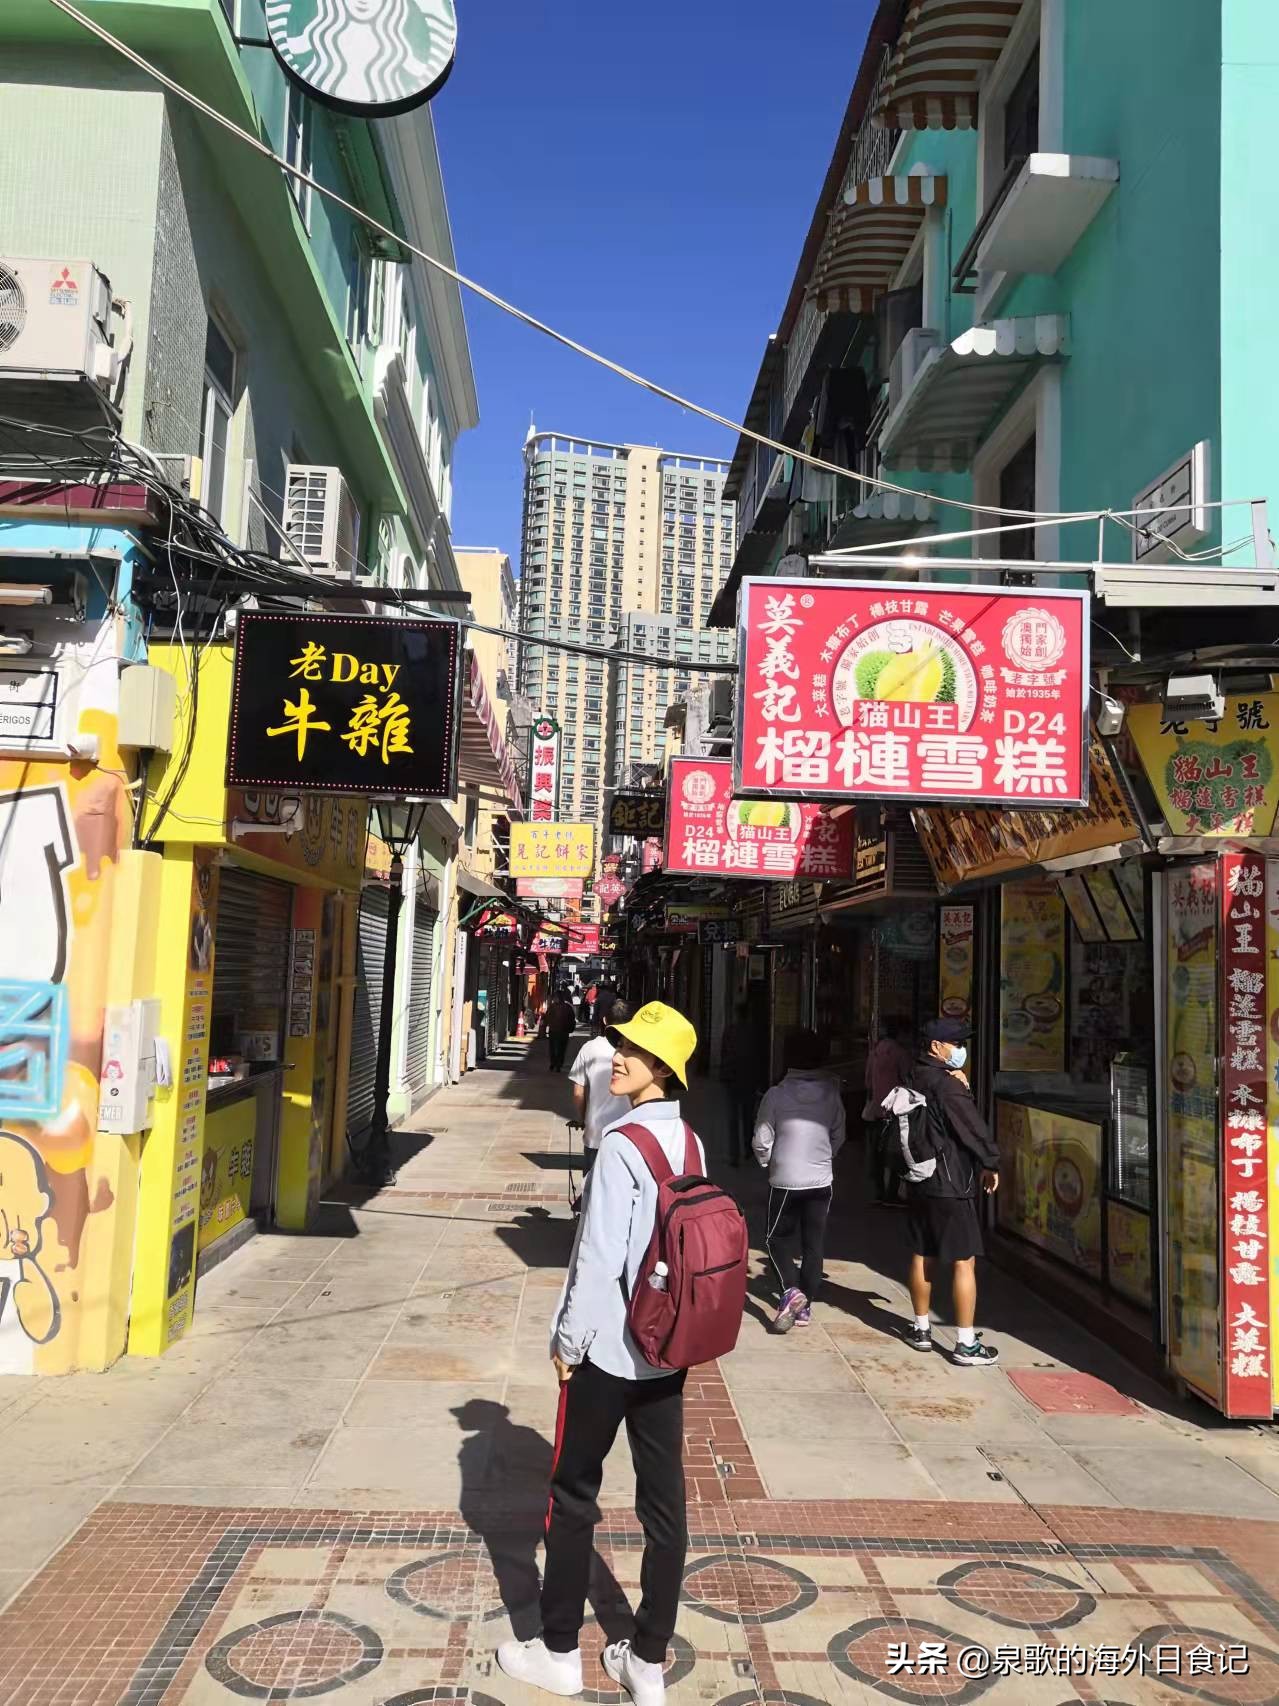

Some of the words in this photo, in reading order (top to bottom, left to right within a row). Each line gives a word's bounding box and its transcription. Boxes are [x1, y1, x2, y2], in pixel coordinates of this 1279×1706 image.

[287, 641, 402, 692] 老Day
[752, 593, 805, 723] 莫義記
[1010, 672, 1056, 686] 老字號
[266, 687, 415, 766] 牛雜
[858, 701, 956, 729] 猫山王
[1003, 709, 1067, 736] D24
[754, 725, 1068, 794] 榴槤雪糕
[1173, 753, 1261, 785] 貓山王
[1168, 784, 1267, 810] 榴蓮雪糕
[681, 838, 838, 874] 榴槤雪糕
[685, 824, 714, 838] D24
[739, 825, 790, 841] 猫山王
[1226, 863, 1265, 955] 貓山王
[1226, 967, 1265, 1072] 榴蓮雪糕
[1226, 1083, 1266, 1178] 木糠布丁
[1228, 1190, 1267, 1286] 楊枝甘露
[1229, 1301, 1269, 1378] 大菜糕
